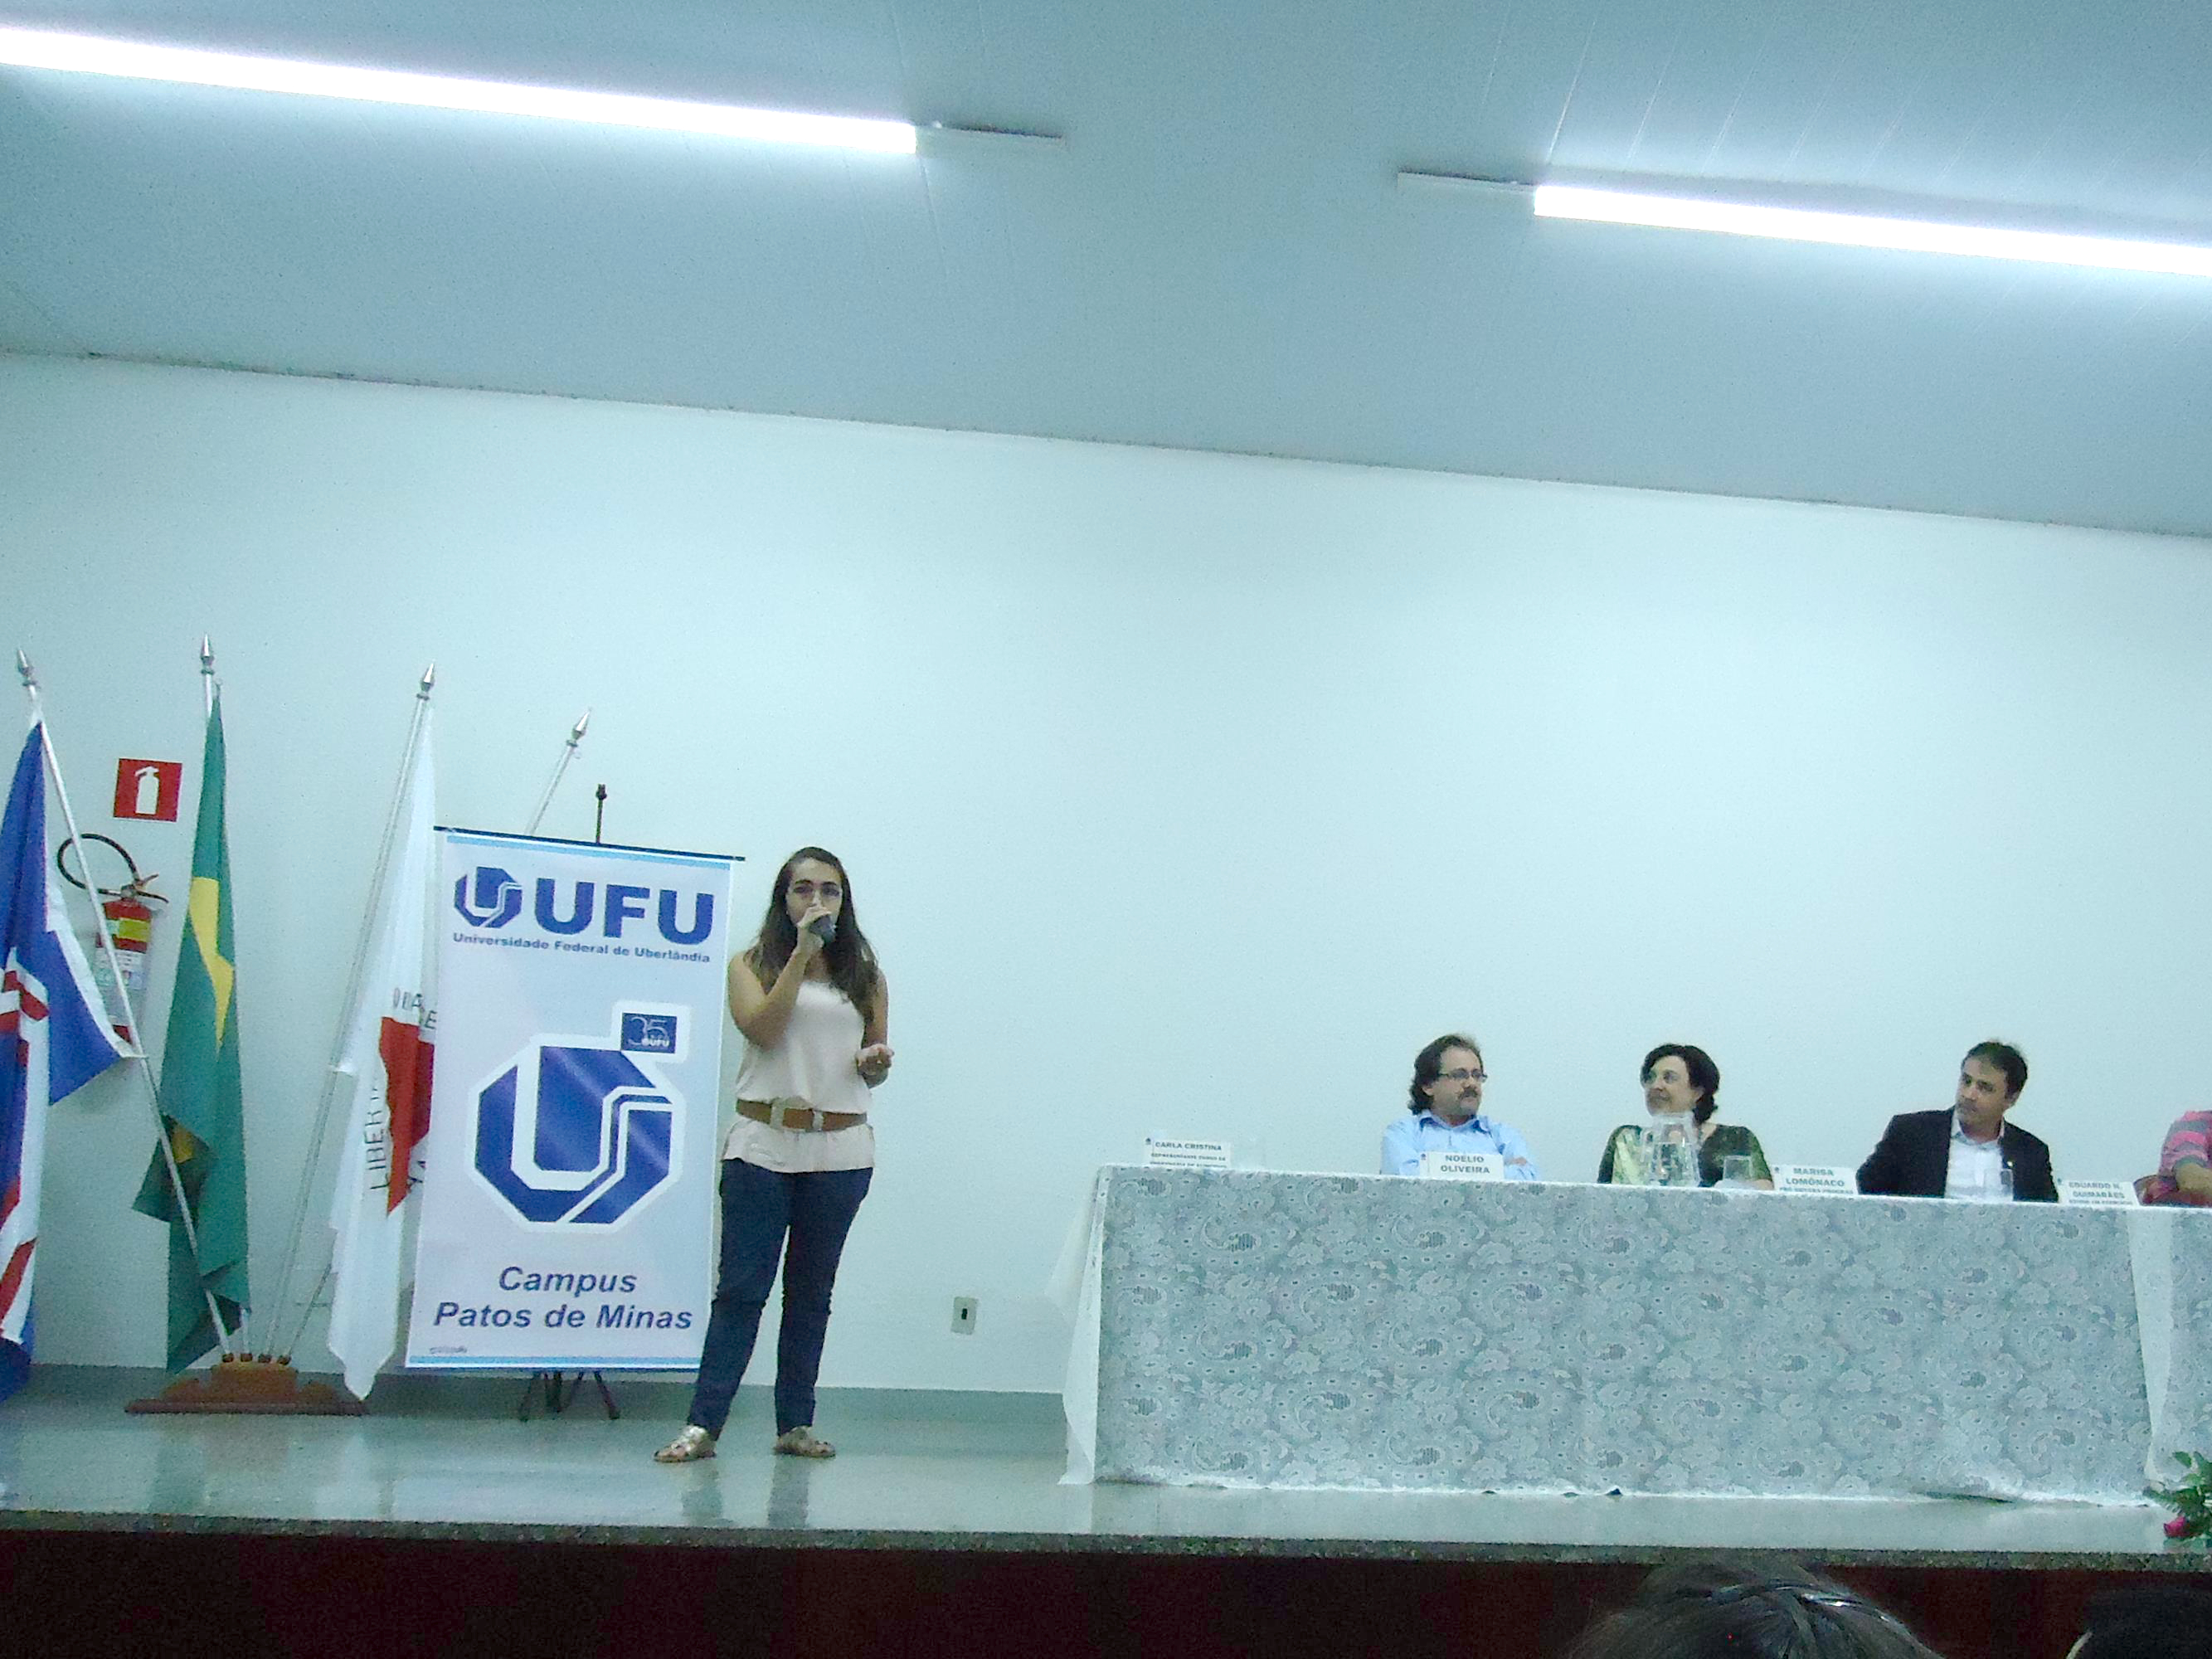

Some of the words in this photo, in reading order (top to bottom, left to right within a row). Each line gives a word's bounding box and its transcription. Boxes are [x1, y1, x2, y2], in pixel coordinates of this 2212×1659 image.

[534, 878, 715, 946] UFU
[453, 932, 550, 950] Universidade
[554, 941, 609, 955] Federal
[613, 946, 630, 956] de
[634, 947, 711, 963] Uberlândia
[1441, 1165, 1490, 1174] OLIVEIRA
[1793, 1168, 1834, 1176] MARISA
[498, 1266, 637, 1298] Campus
[433, 1301, 532, 1329] Patos
[544, 1304, 586, 1329] de
[596, 1304, 693, 1330] Minas
